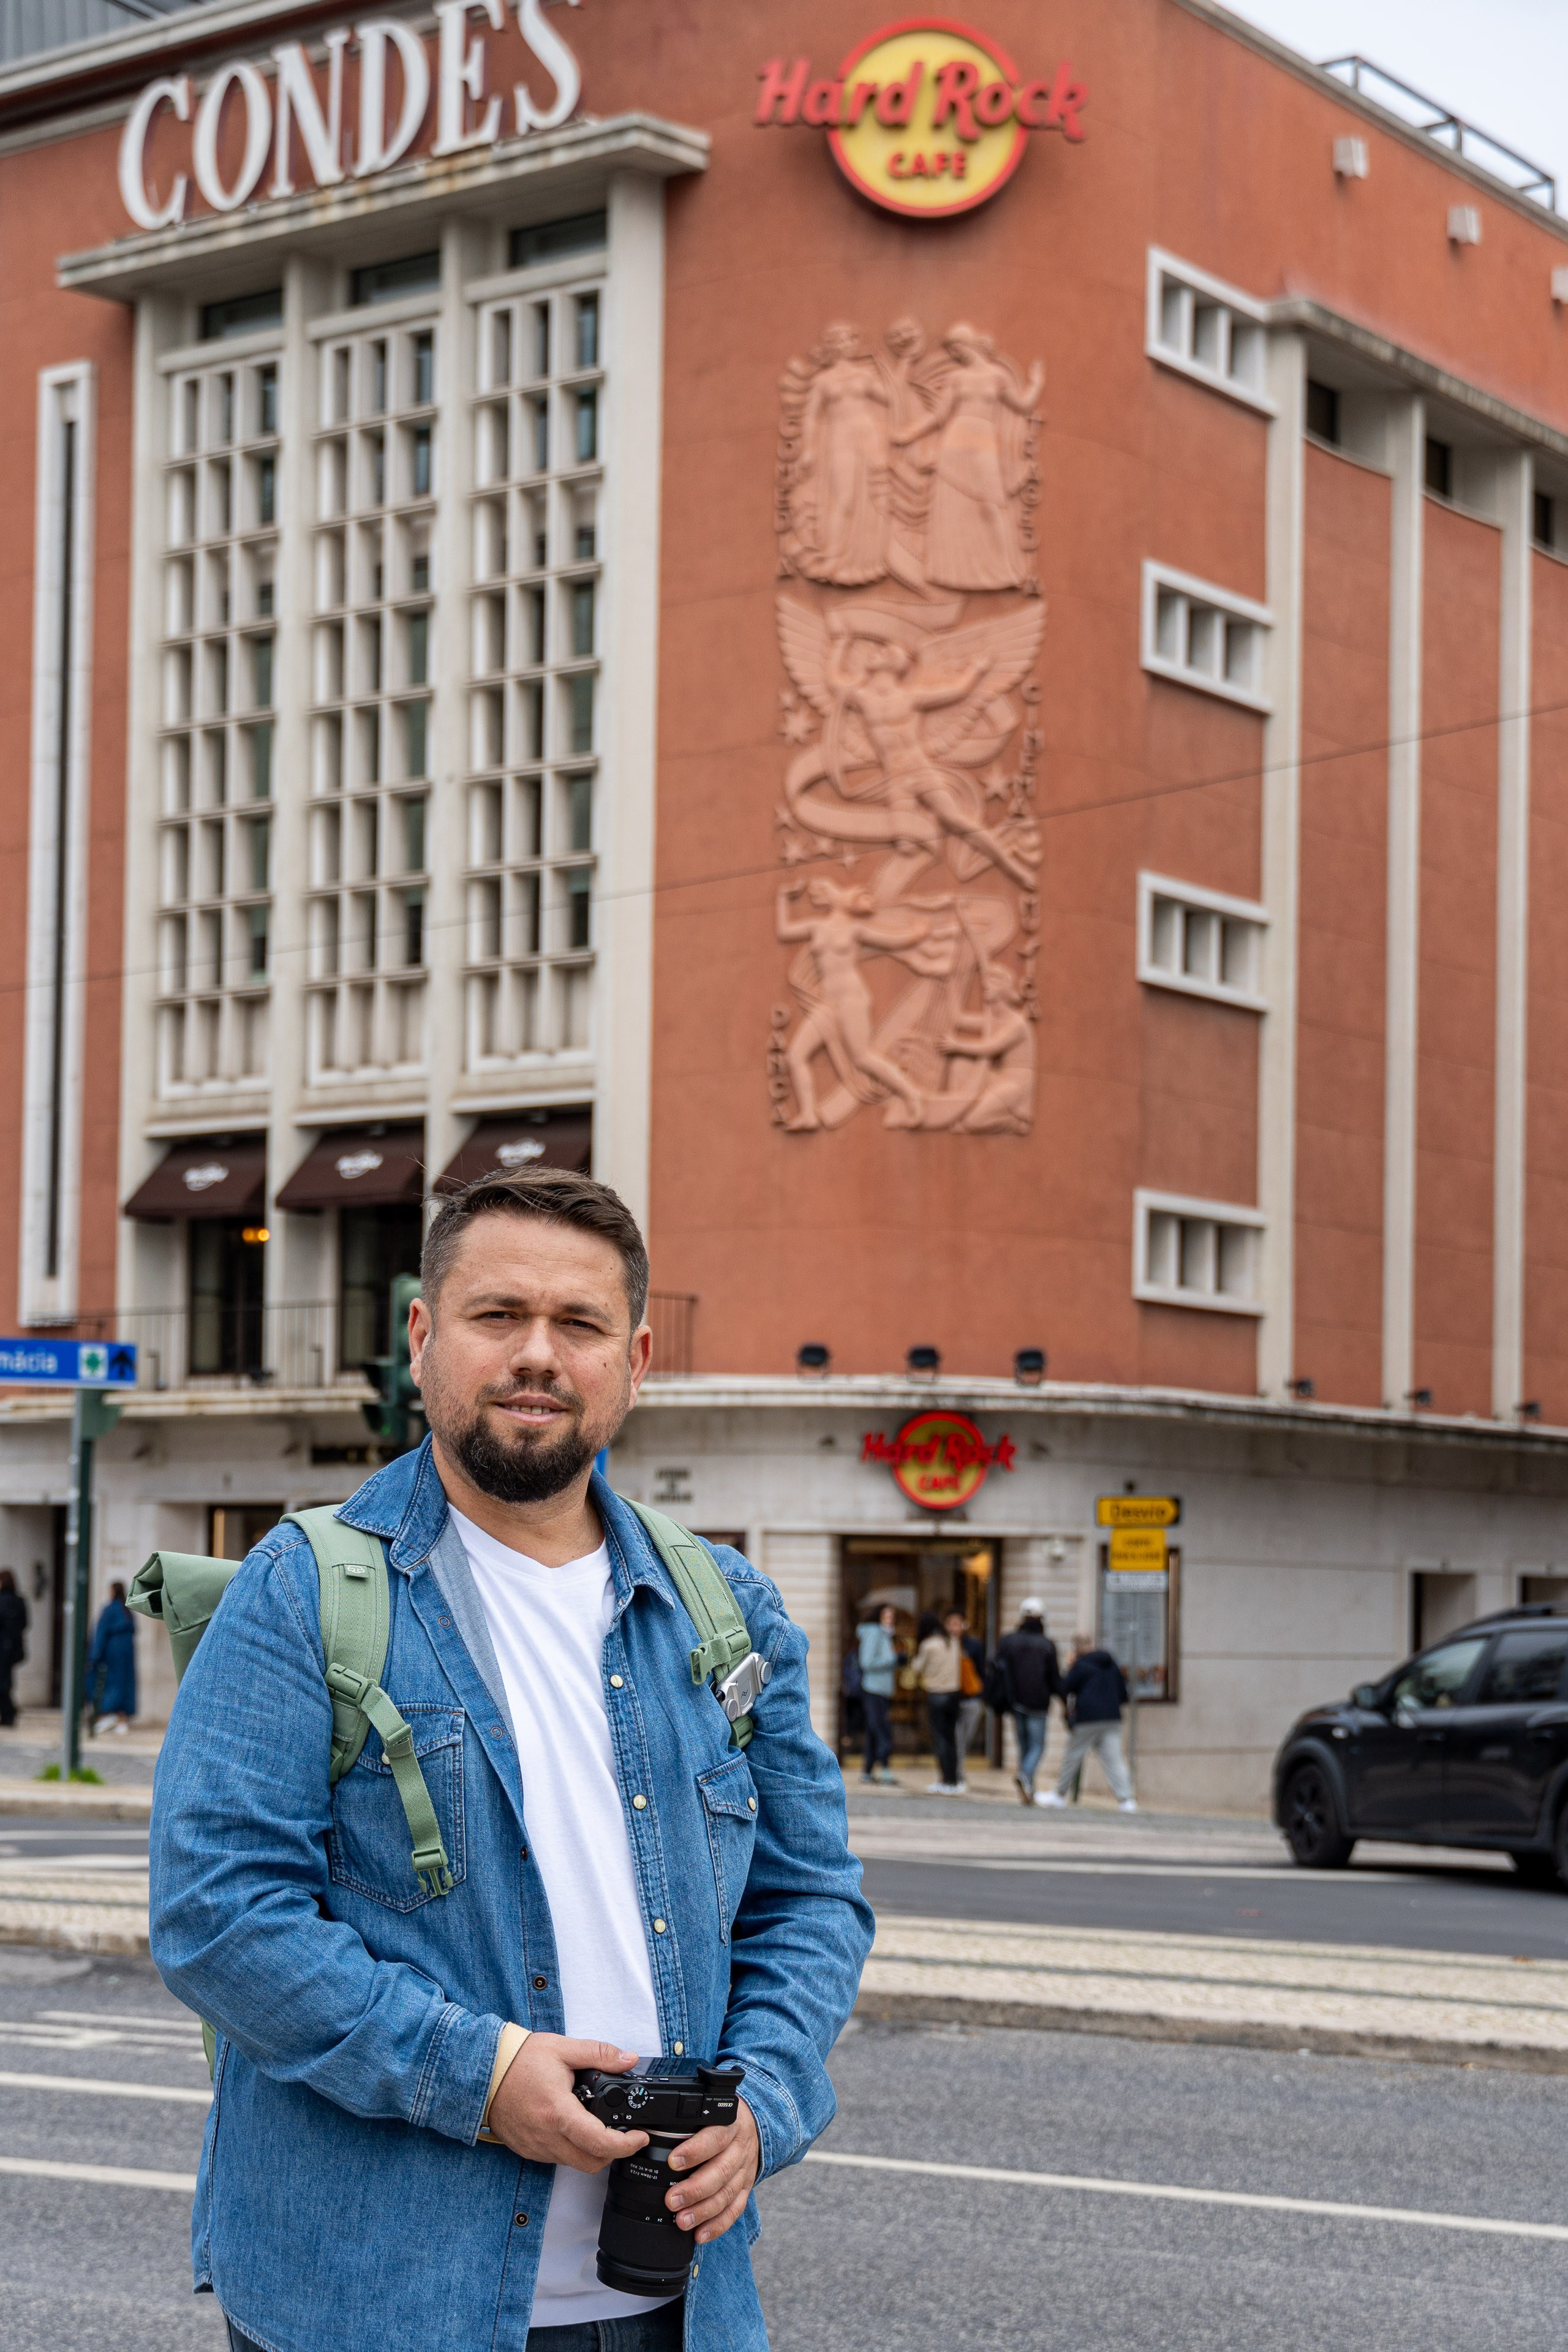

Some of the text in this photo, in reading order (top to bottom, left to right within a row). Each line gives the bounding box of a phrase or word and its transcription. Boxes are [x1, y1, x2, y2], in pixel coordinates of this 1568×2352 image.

[118, 0, 581, 230] CONDES
[754, 56, 1088, 142] Hard Rock
[888, 152, 967, 179] CAFE
[861, 1432, 1017, 1472] Hard Rock
